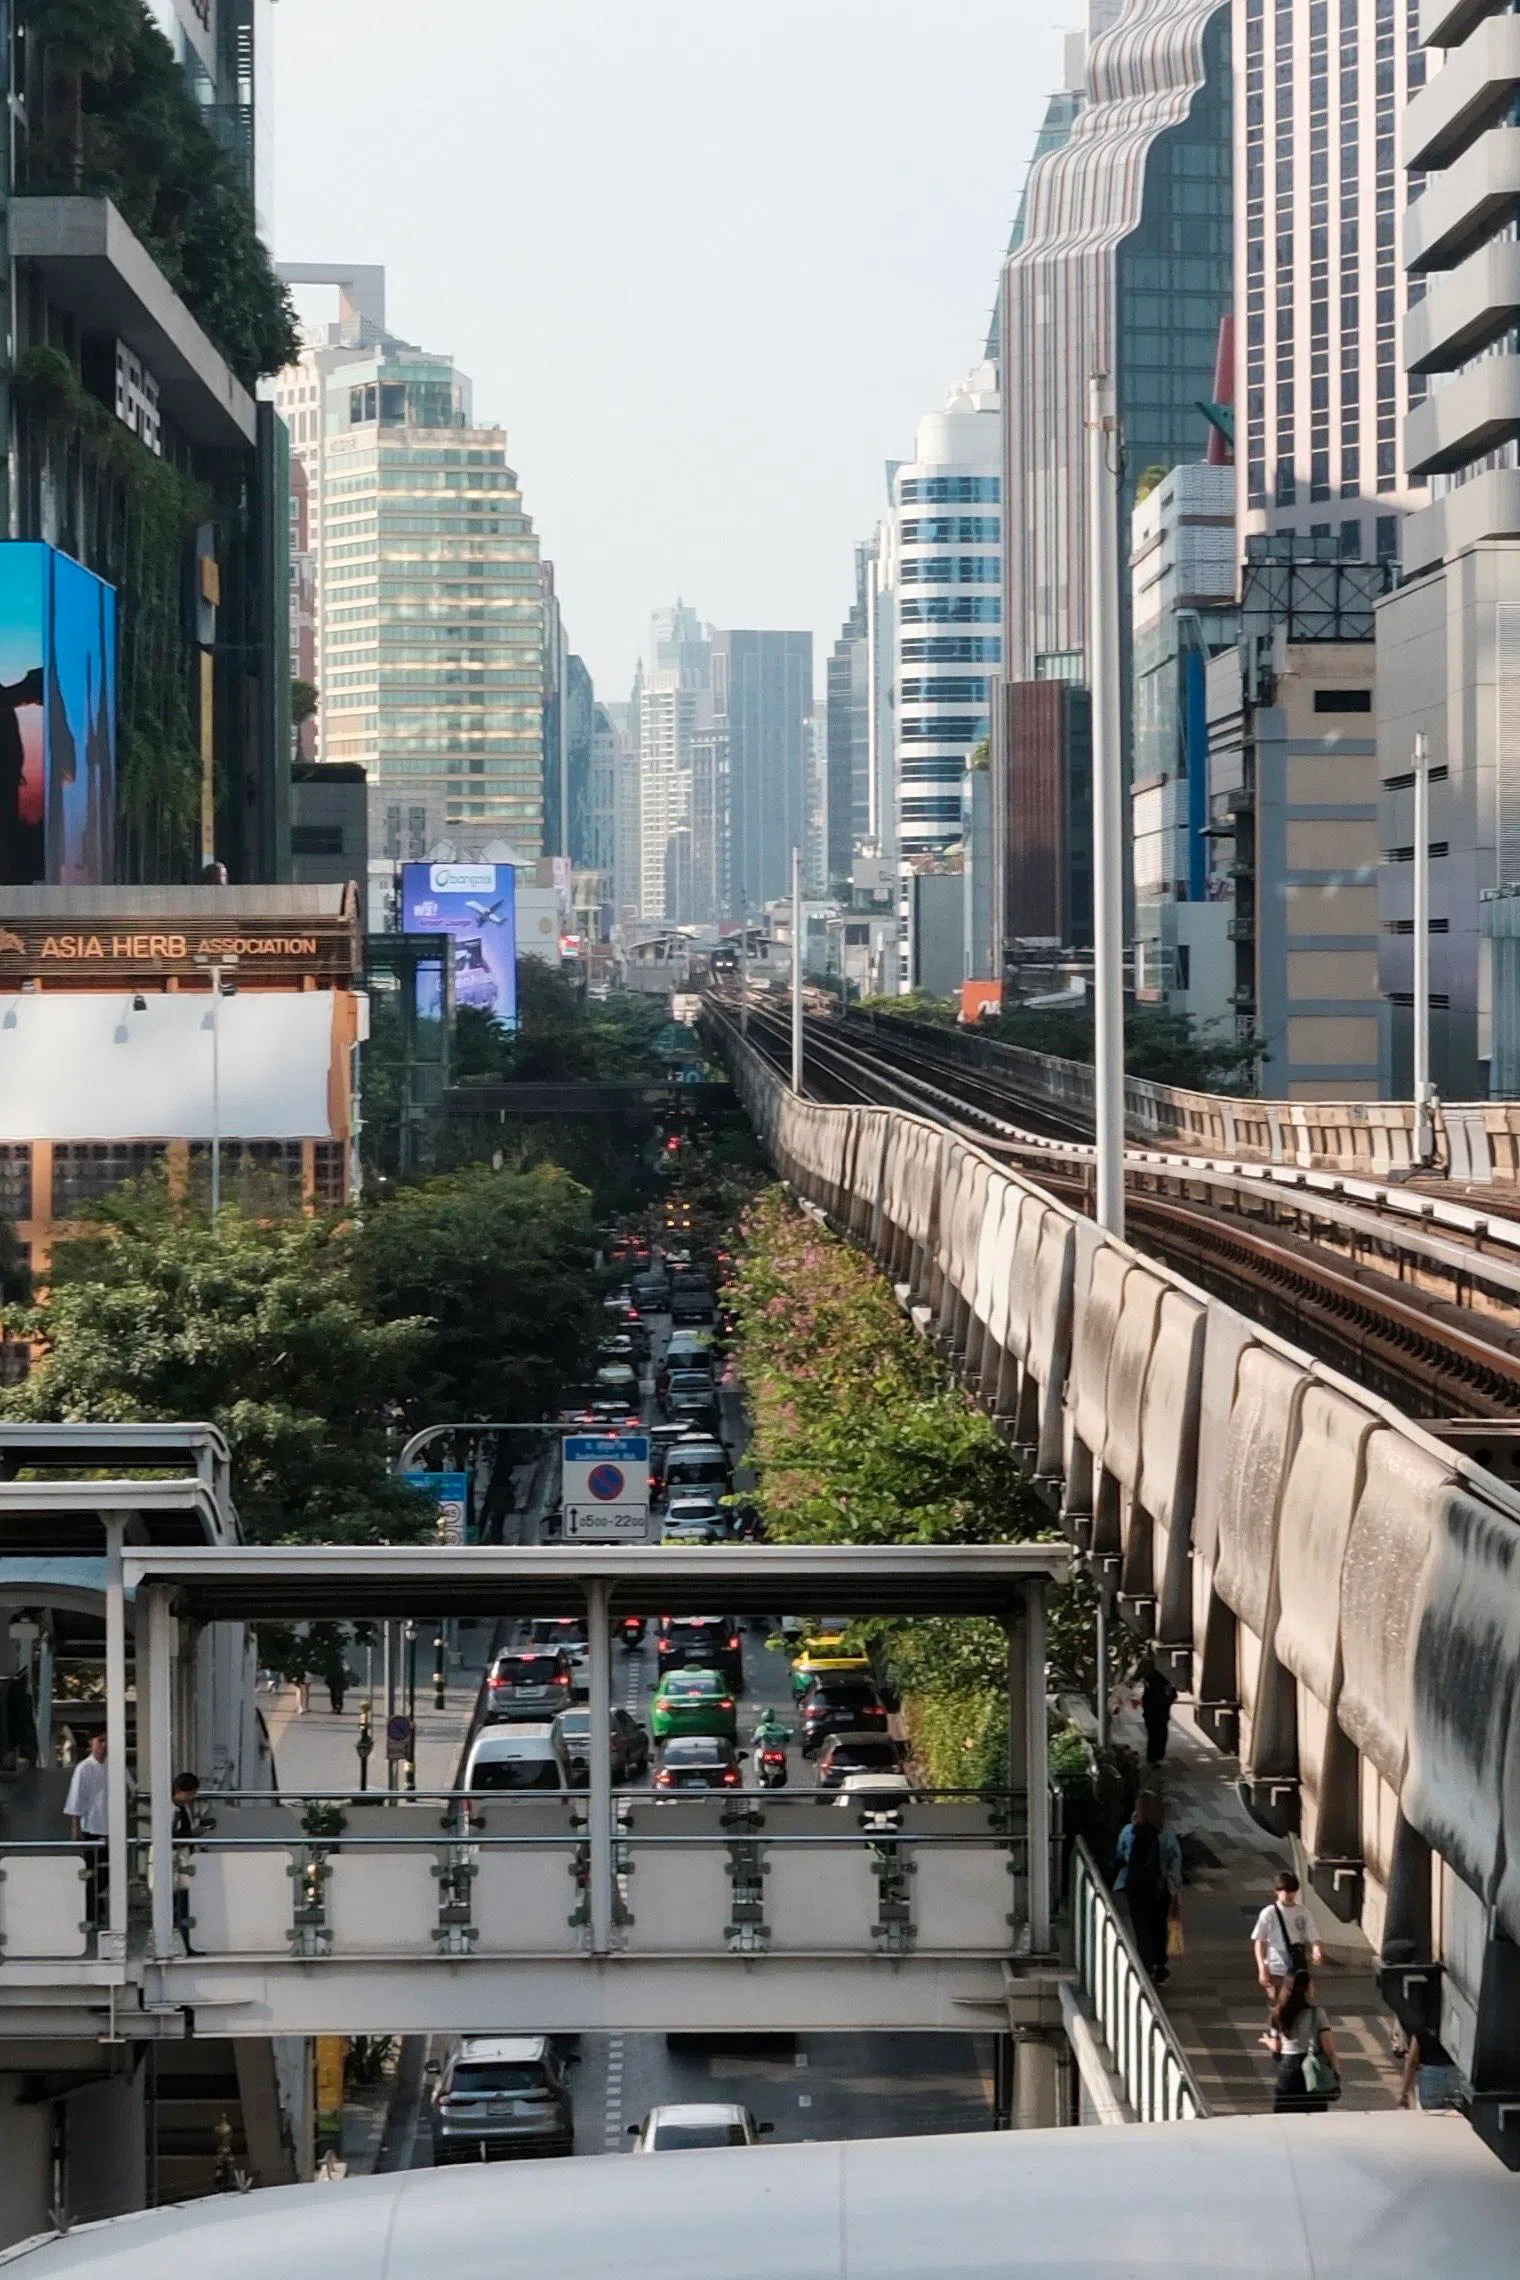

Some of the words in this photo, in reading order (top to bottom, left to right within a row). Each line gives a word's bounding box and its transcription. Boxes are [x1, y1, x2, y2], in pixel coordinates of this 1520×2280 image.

[41, 935, 103, 958] ASIA
[112, 935, 187, 959] HERB
[198, 937, 317, 956] ASSOCIATION
